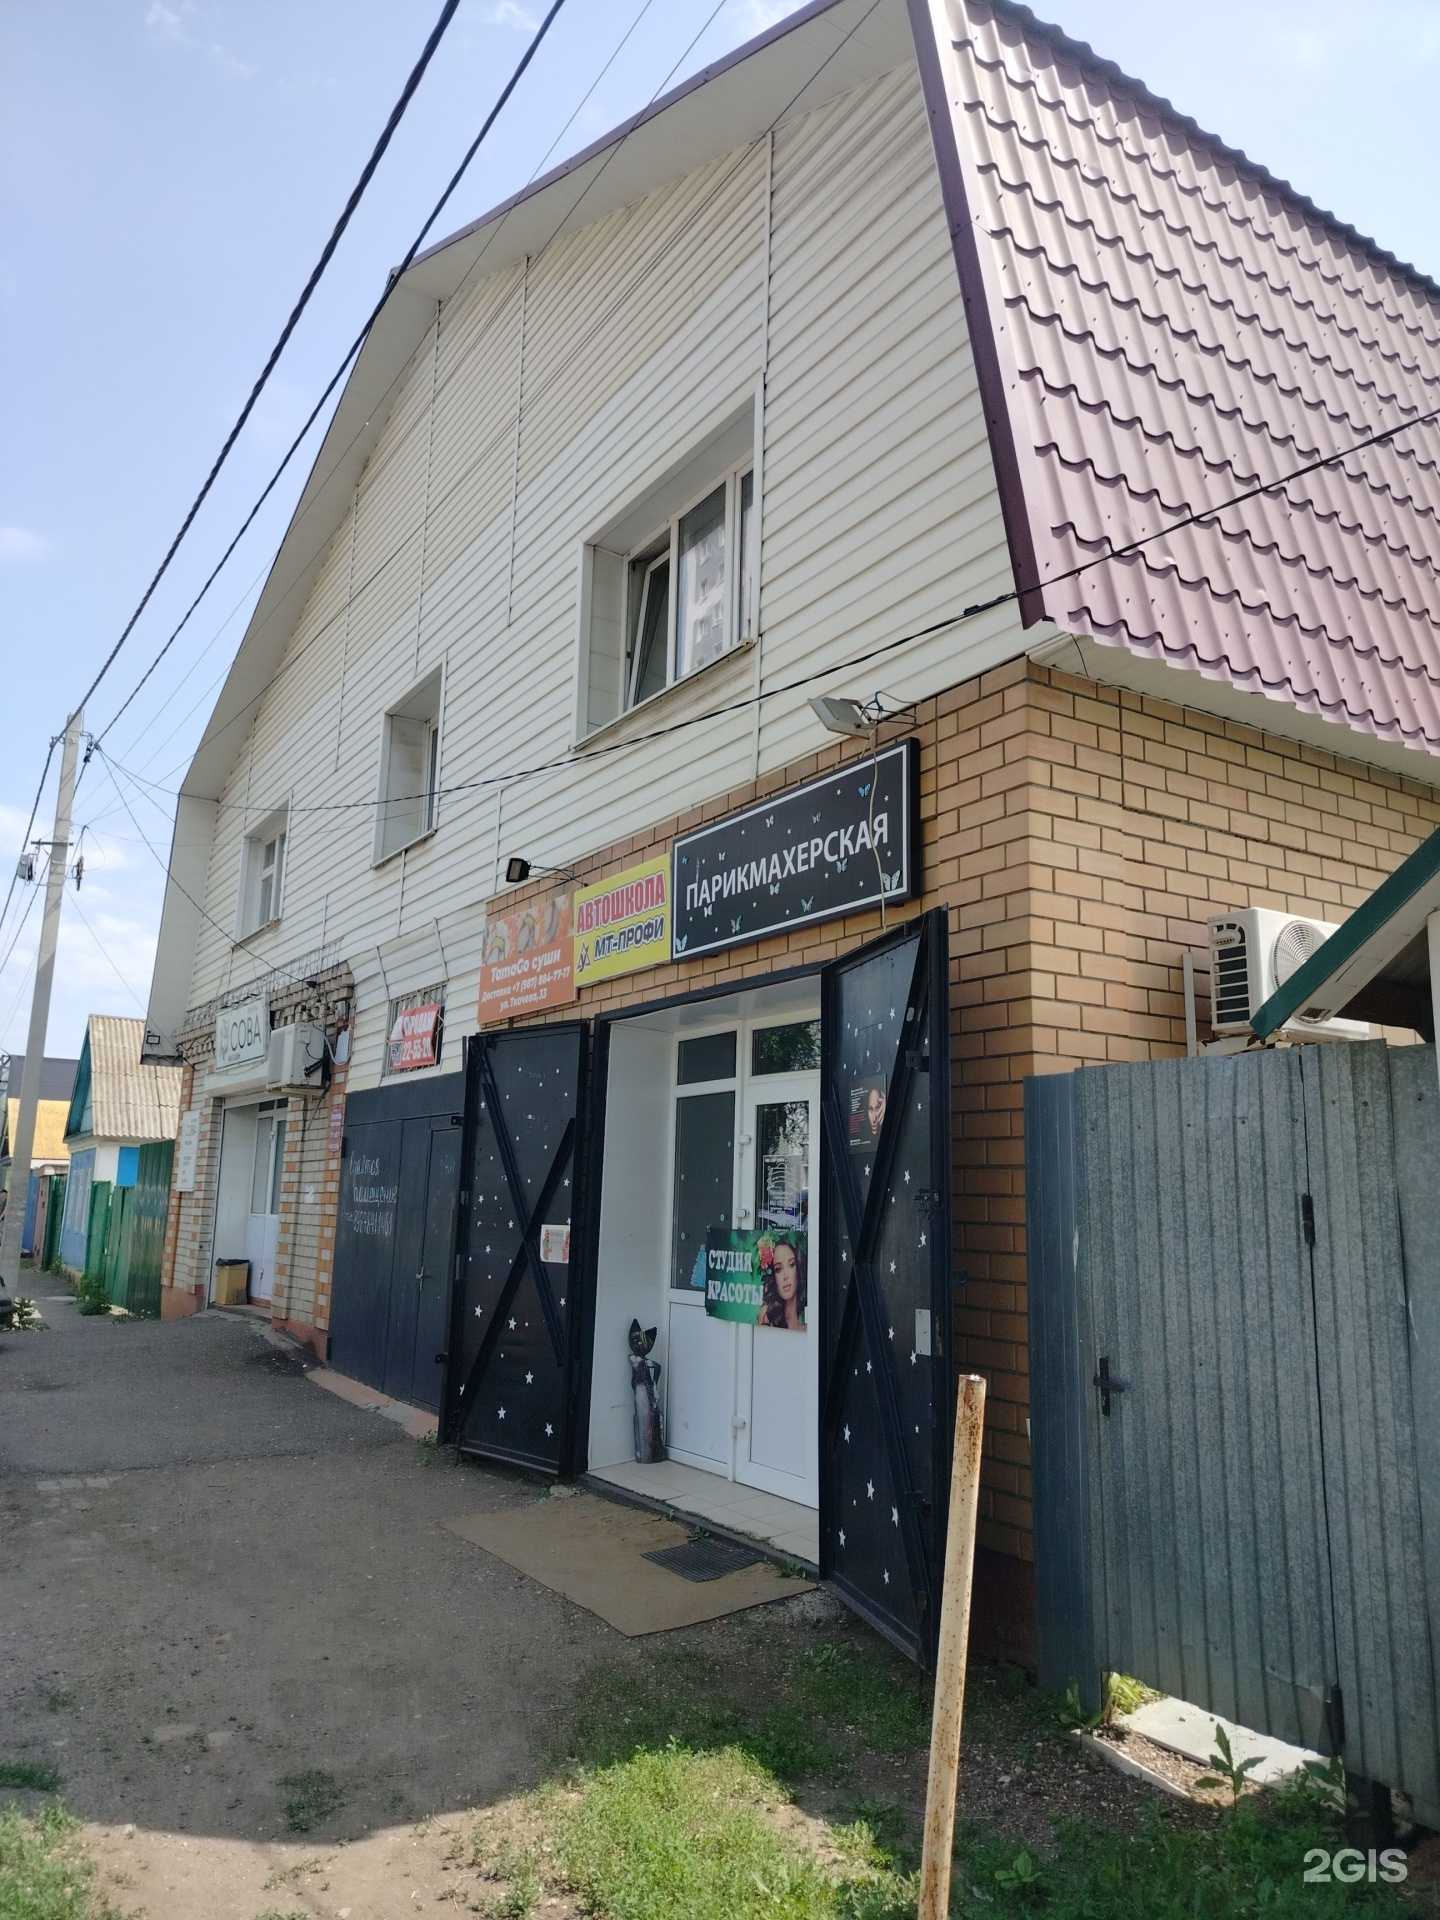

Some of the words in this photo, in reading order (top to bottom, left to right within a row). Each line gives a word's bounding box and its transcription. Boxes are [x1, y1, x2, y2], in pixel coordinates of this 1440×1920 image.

[686, 812, 888, 911] ПАРИКМАХЕРСКАЯ
[576, 872, 666, 934] АВТОШКОЛА
[594, 915, 665, 961] МТ-ПРОФИ
[532, 948, 561, 973] суши
[231, 1013, 262, 1053] СОВА
[707, 1279, 765, 1306] КРАСОТЫ
